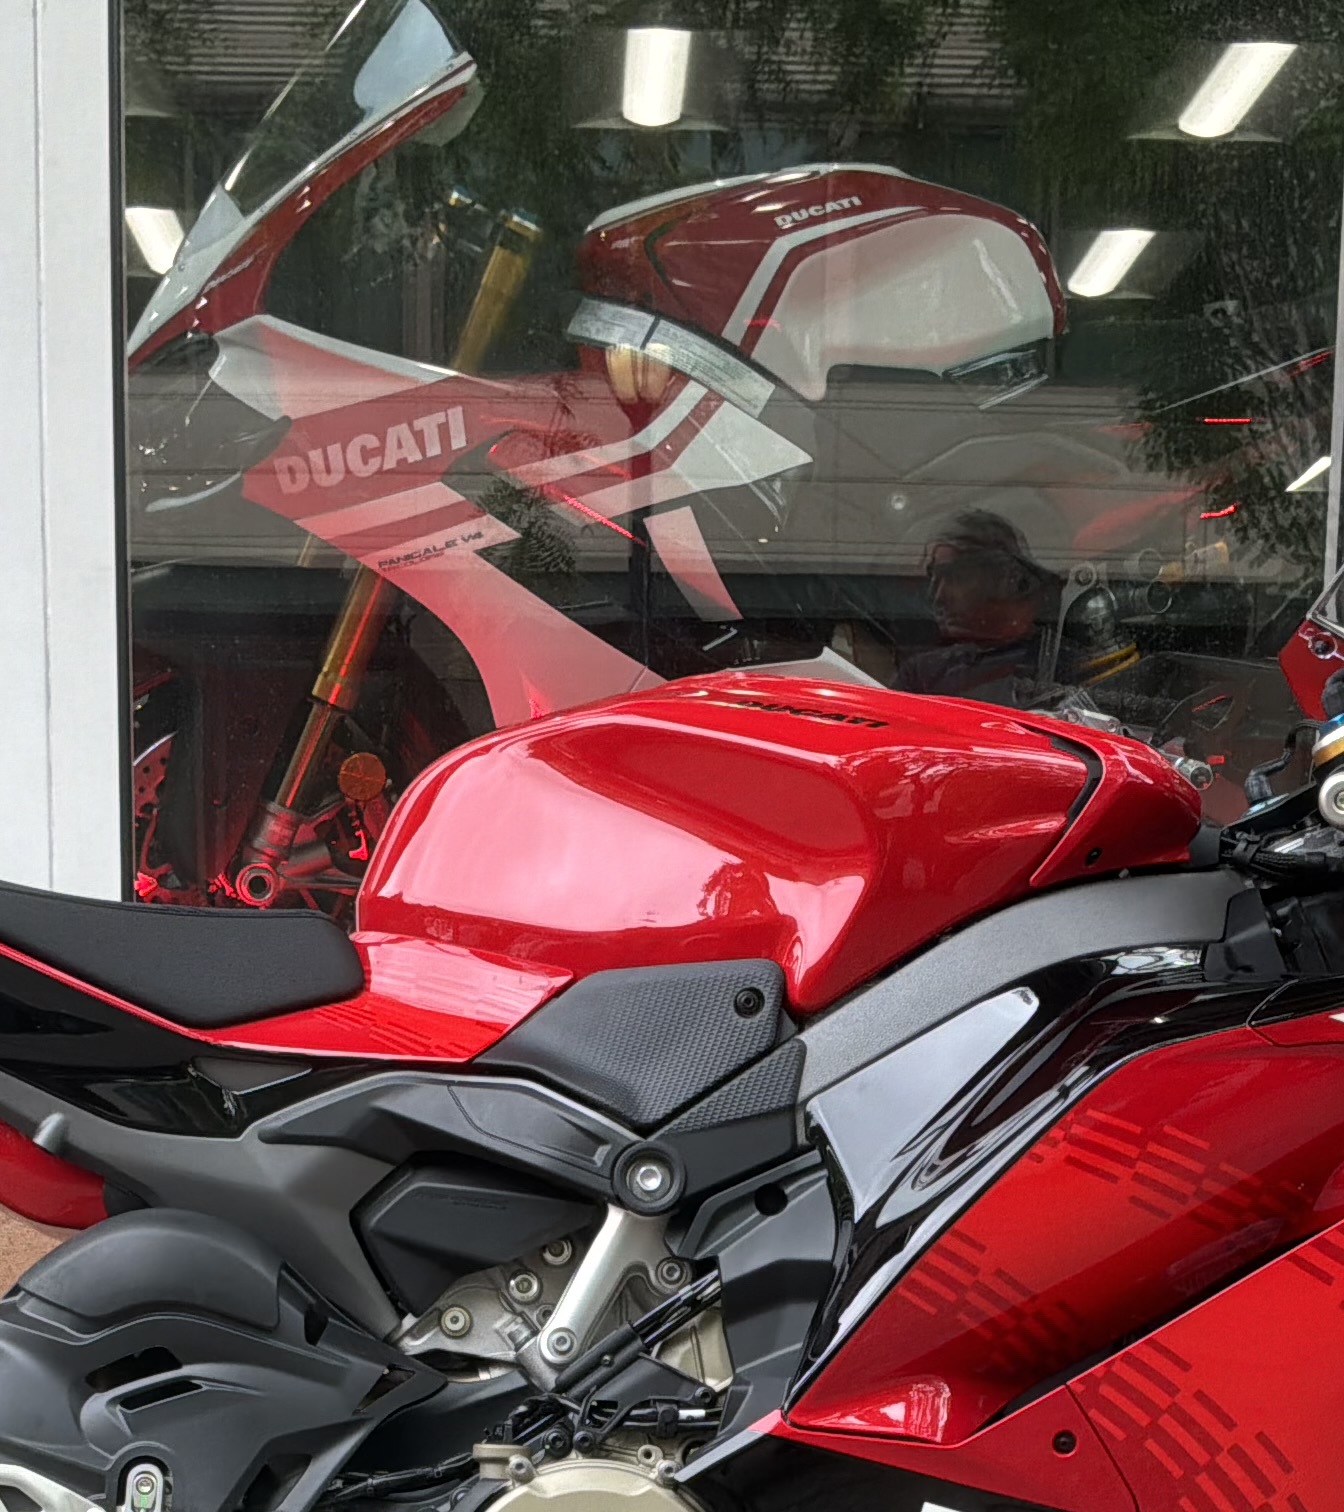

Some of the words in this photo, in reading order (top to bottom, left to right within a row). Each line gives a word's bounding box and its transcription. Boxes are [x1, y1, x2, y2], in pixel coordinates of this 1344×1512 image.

[774, 196, 862, 227] DUCATI
[273, 406, 467, 495] DUCATI
[378, 539, 458, 569] PANIGALE
[461, 531, 484, 543] V4
